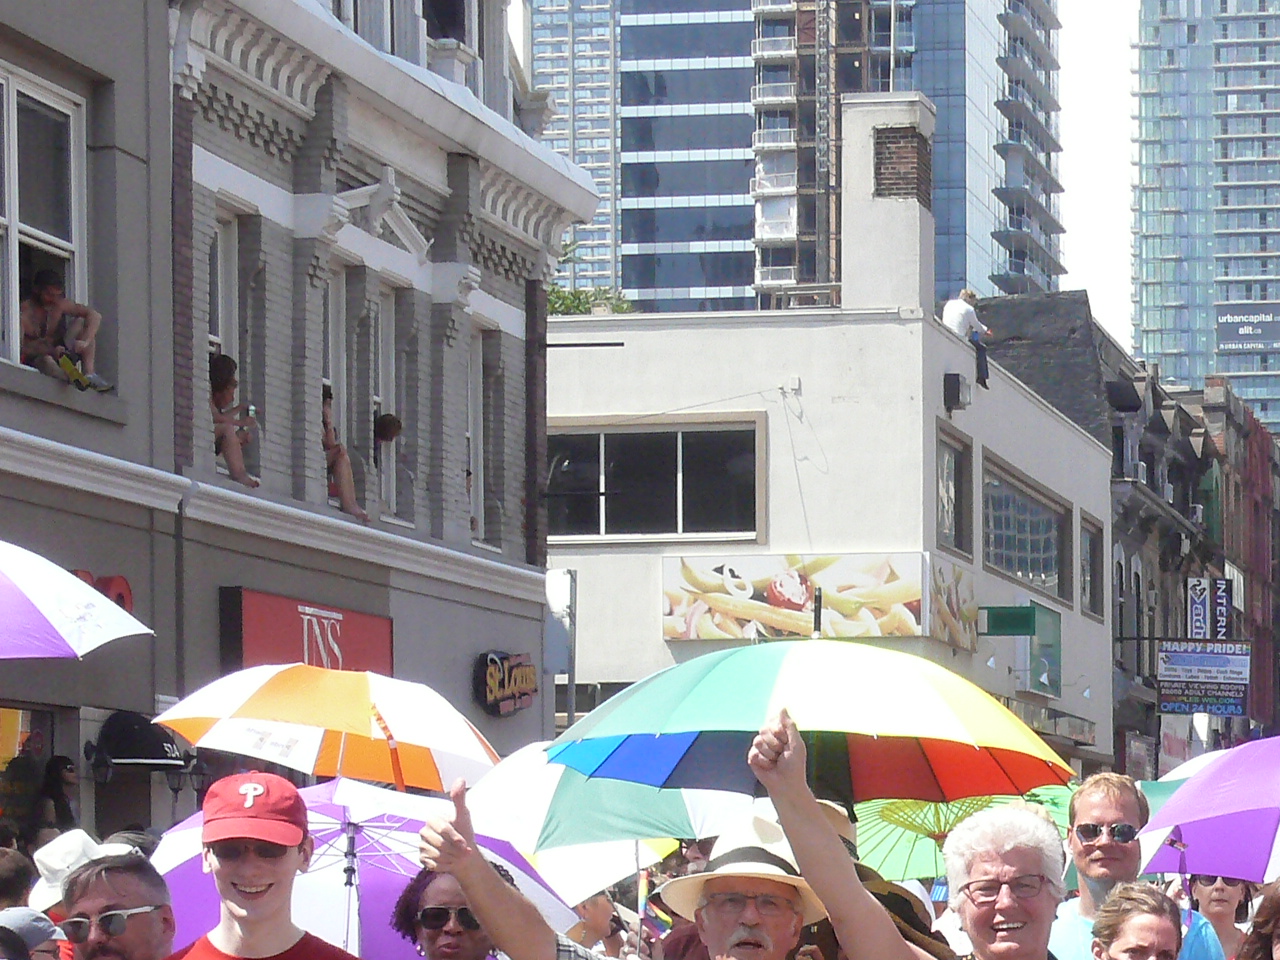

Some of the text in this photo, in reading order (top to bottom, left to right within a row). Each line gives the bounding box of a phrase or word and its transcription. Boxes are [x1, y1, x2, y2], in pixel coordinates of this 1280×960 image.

[1162, 641, 1247, 655] HAPPY PRIDE!
[1160, 702, 1243, 714] OPEN 24 HOURS
